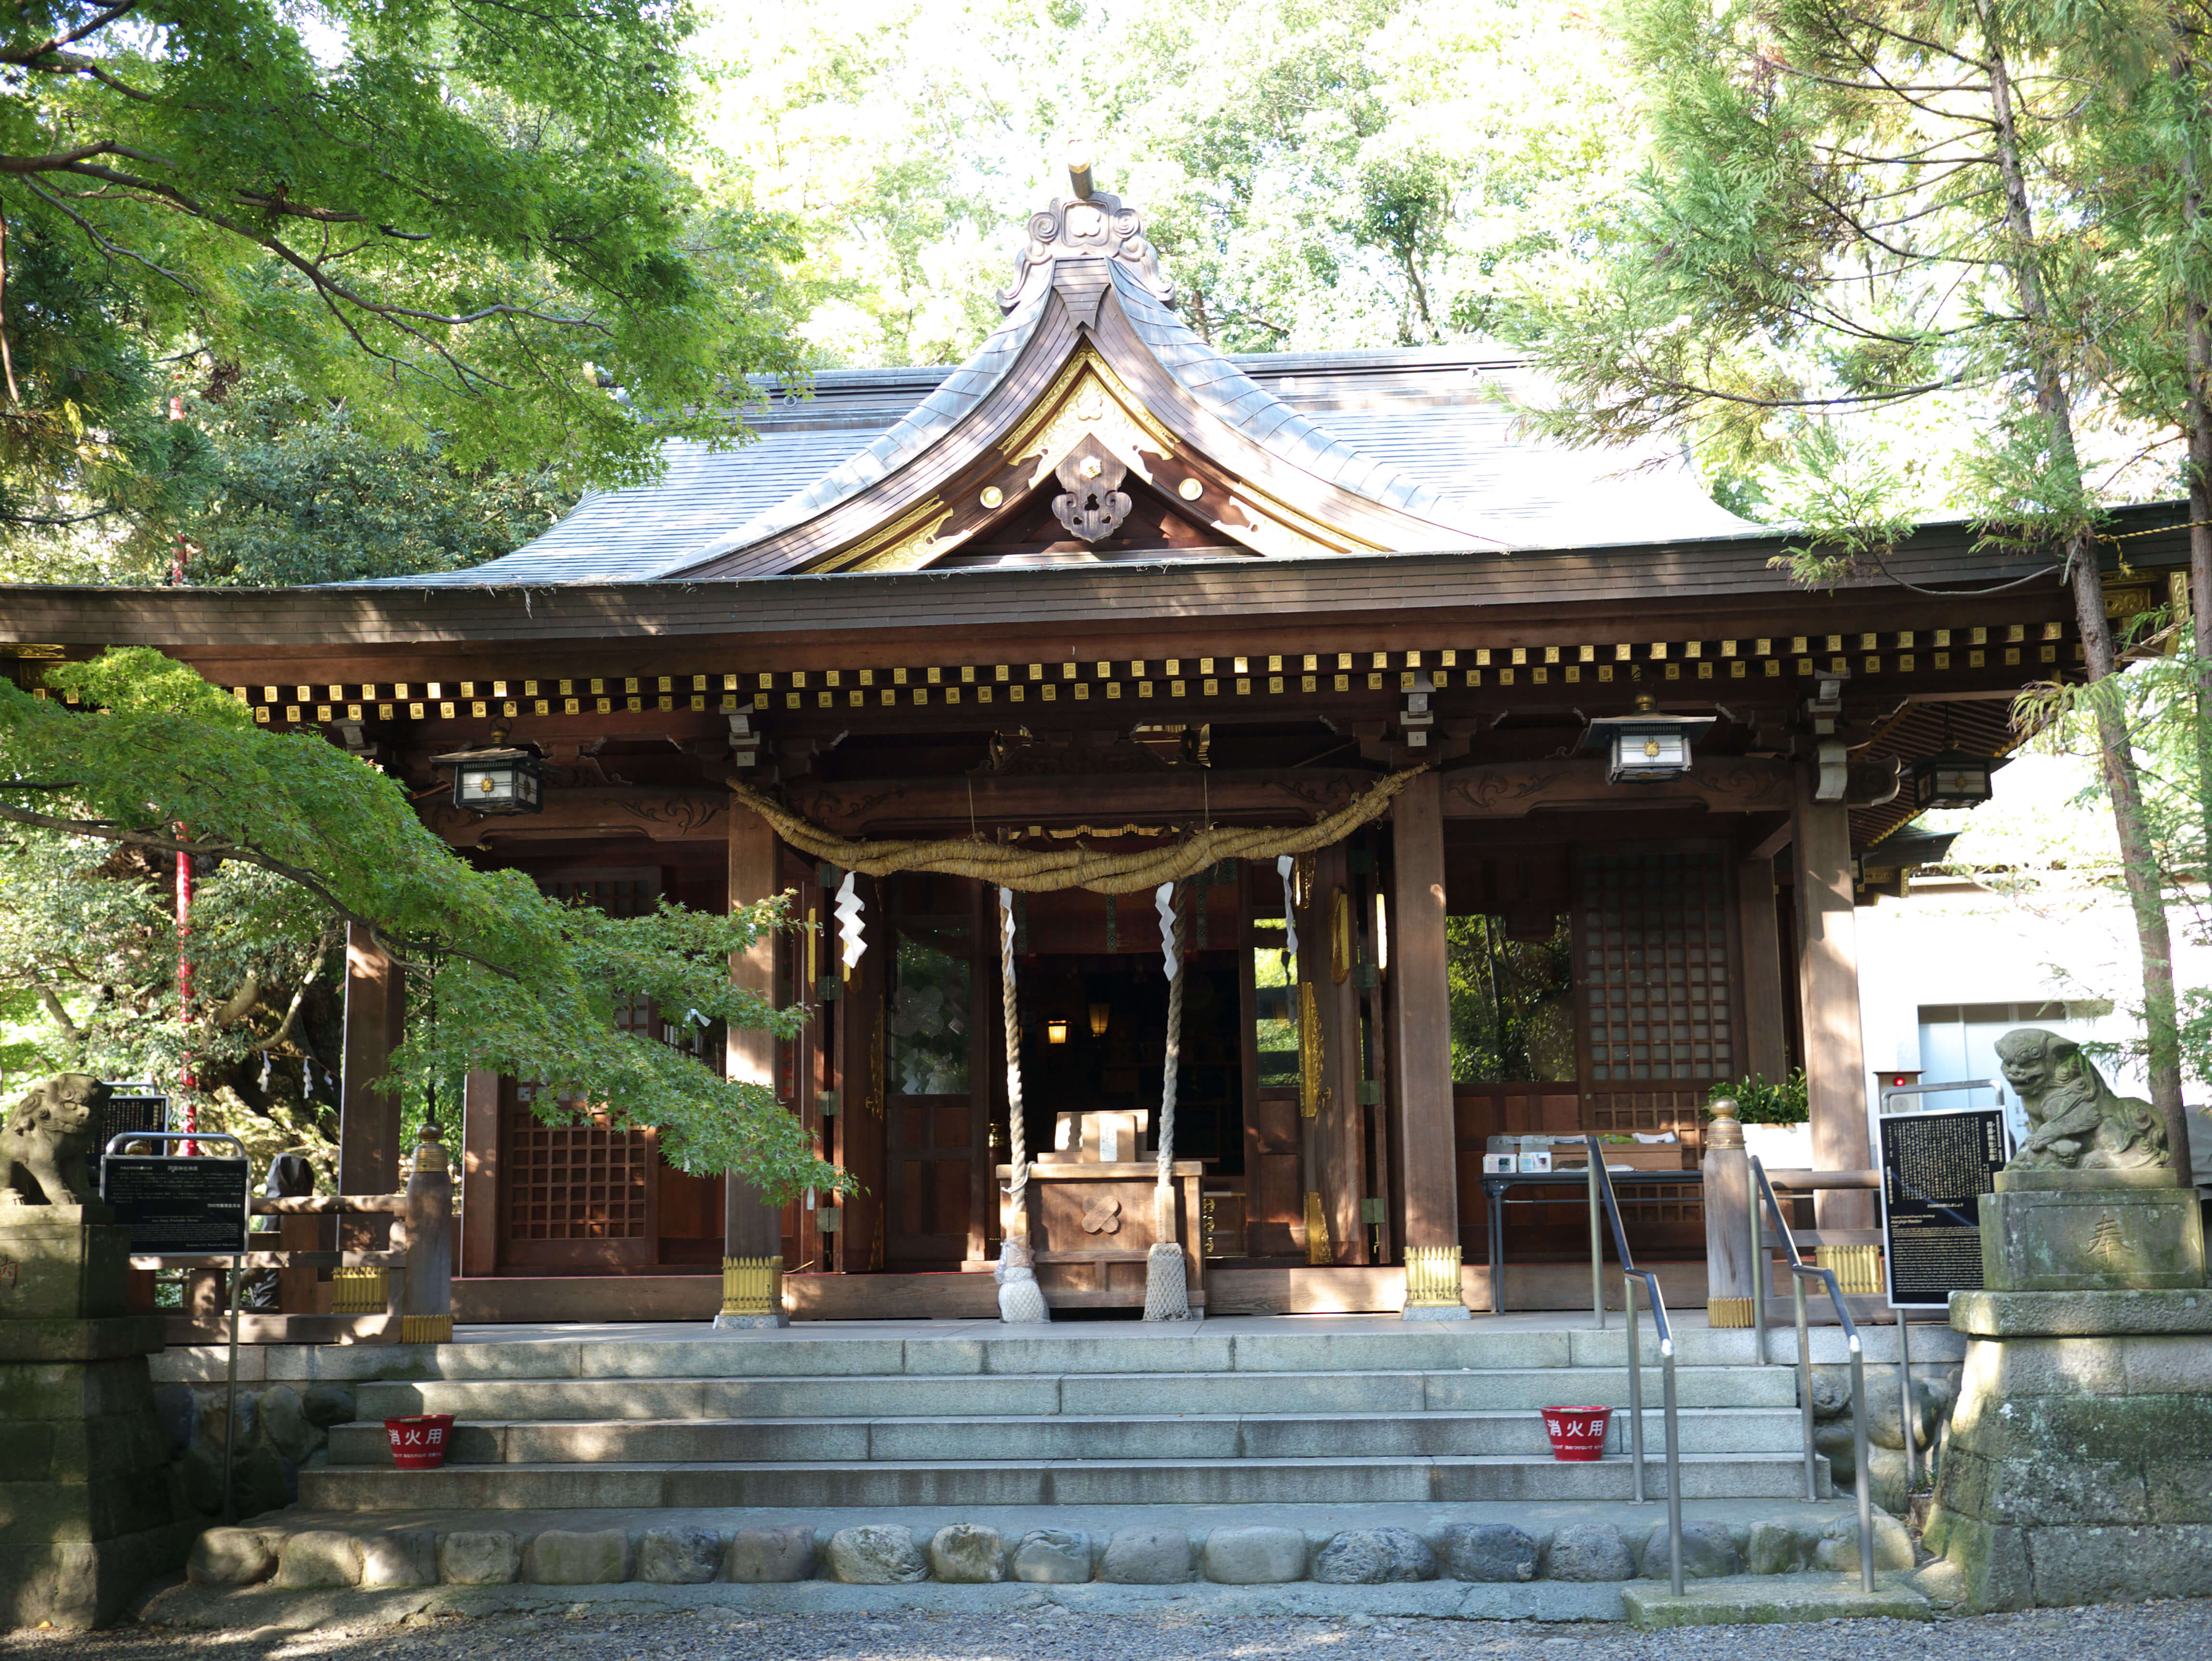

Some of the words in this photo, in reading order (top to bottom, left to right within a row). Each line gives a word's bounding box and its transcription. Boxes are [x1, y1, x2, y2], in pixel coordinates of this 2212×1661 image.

[2087, 1214, 2134, 1264] 奉
[388, 1428, 442, 1445] 消火用
[1547, 1419, 1604, 1437] 消火用
